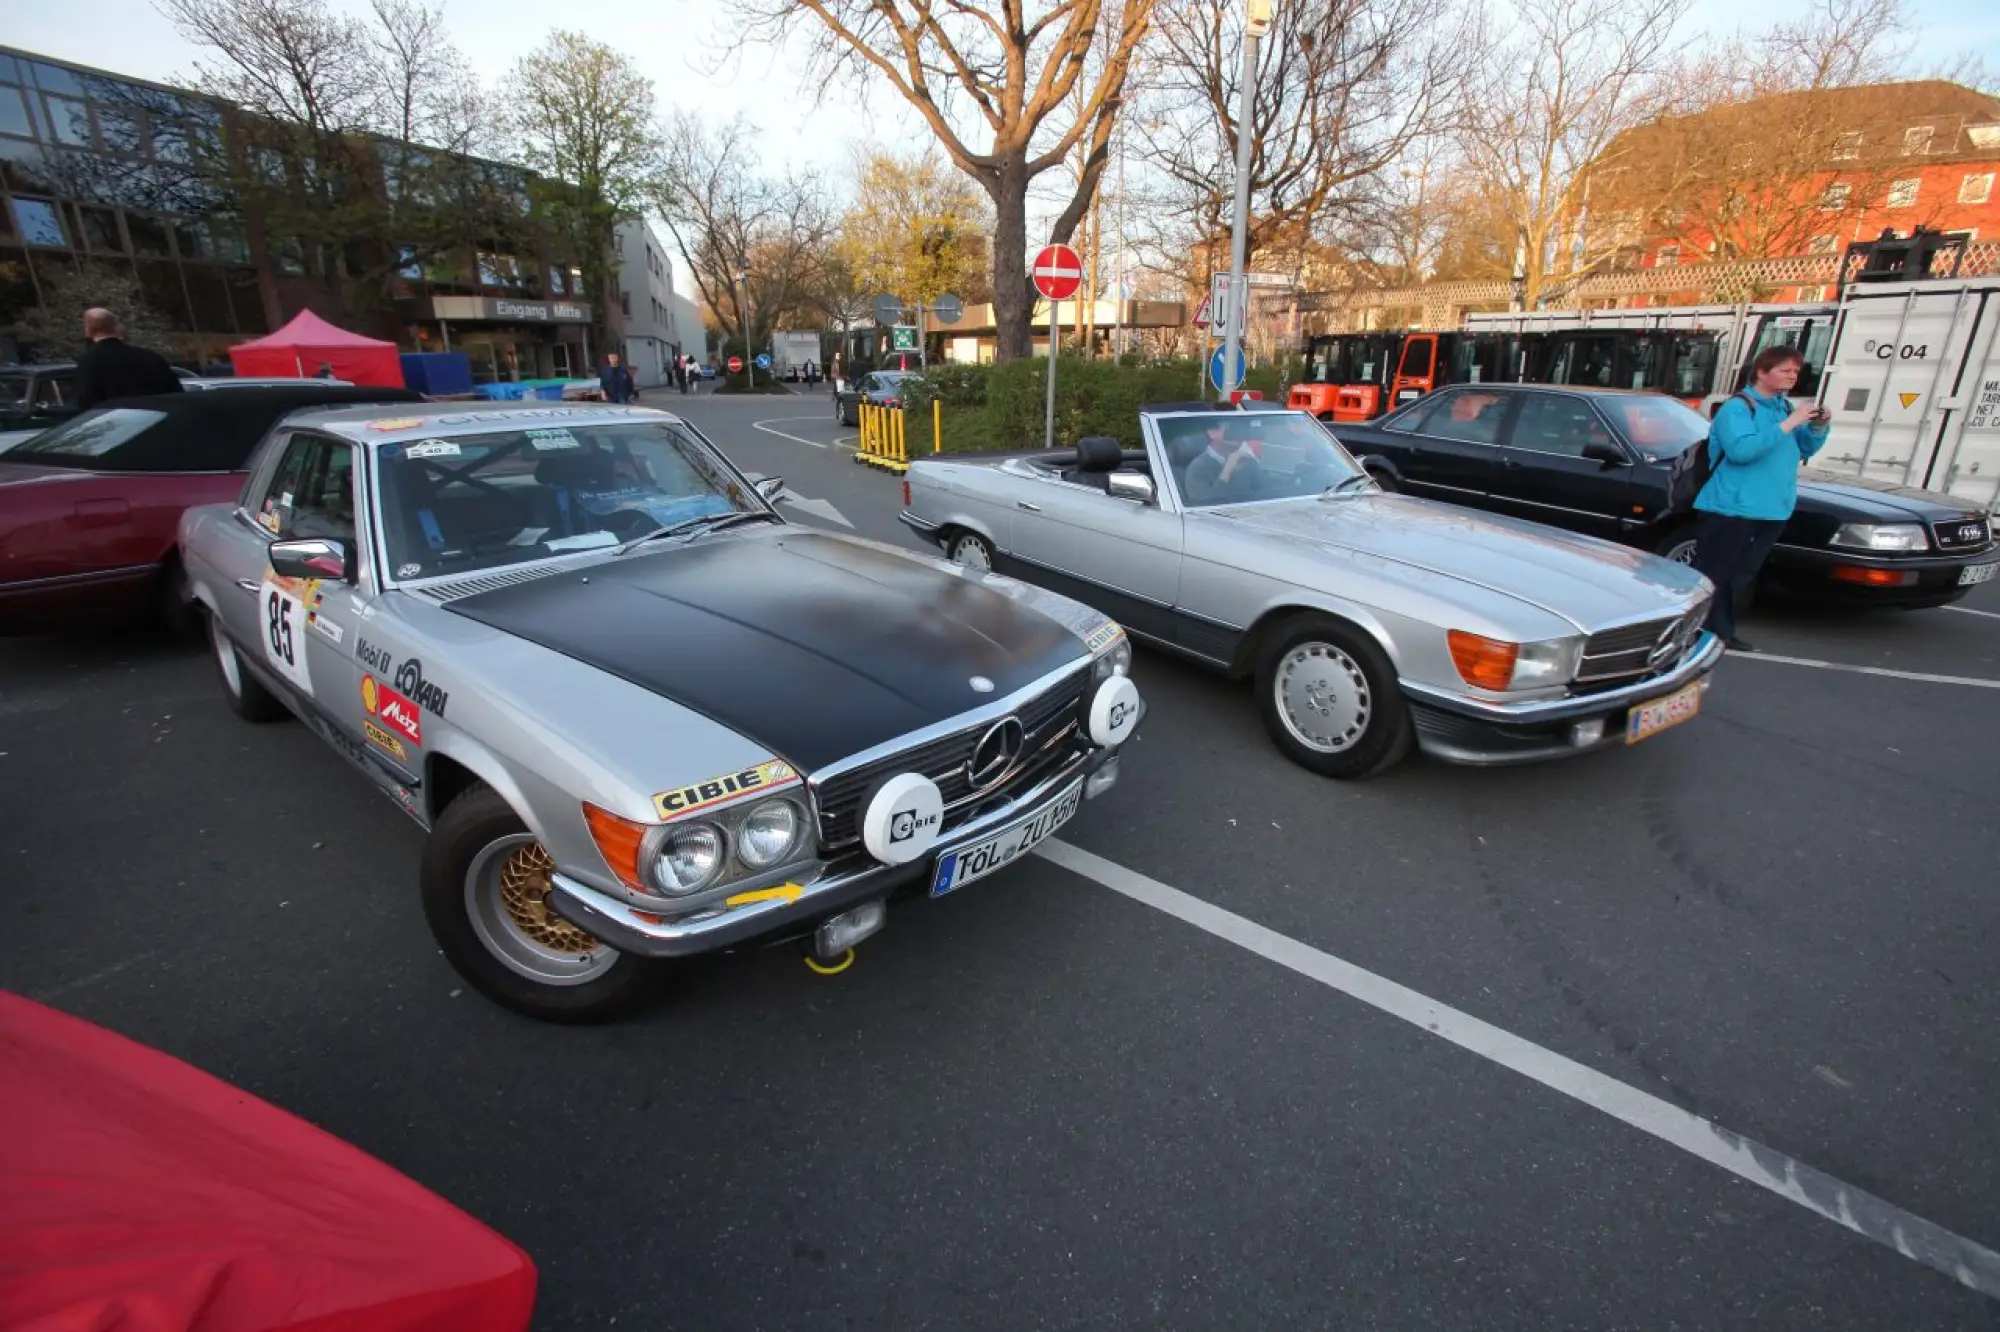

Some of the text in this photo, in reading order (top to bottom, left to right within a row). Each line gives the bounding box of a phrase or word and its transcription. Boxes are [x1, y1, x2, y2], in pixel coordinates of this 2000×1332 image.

[496, 301, 581, 320] Eingang Mitte
[1900, 344, 1928, 360] 04
[268, 591, 295, 667] 85
[381, 700, 419, 738] Metz
[662, 769, 762, 811] CIBIE
[901, 813, 937, 832] CIBIE
[958, 841, 1001, 881] TÖL
[1017, 817, 1046, 852] ZU
